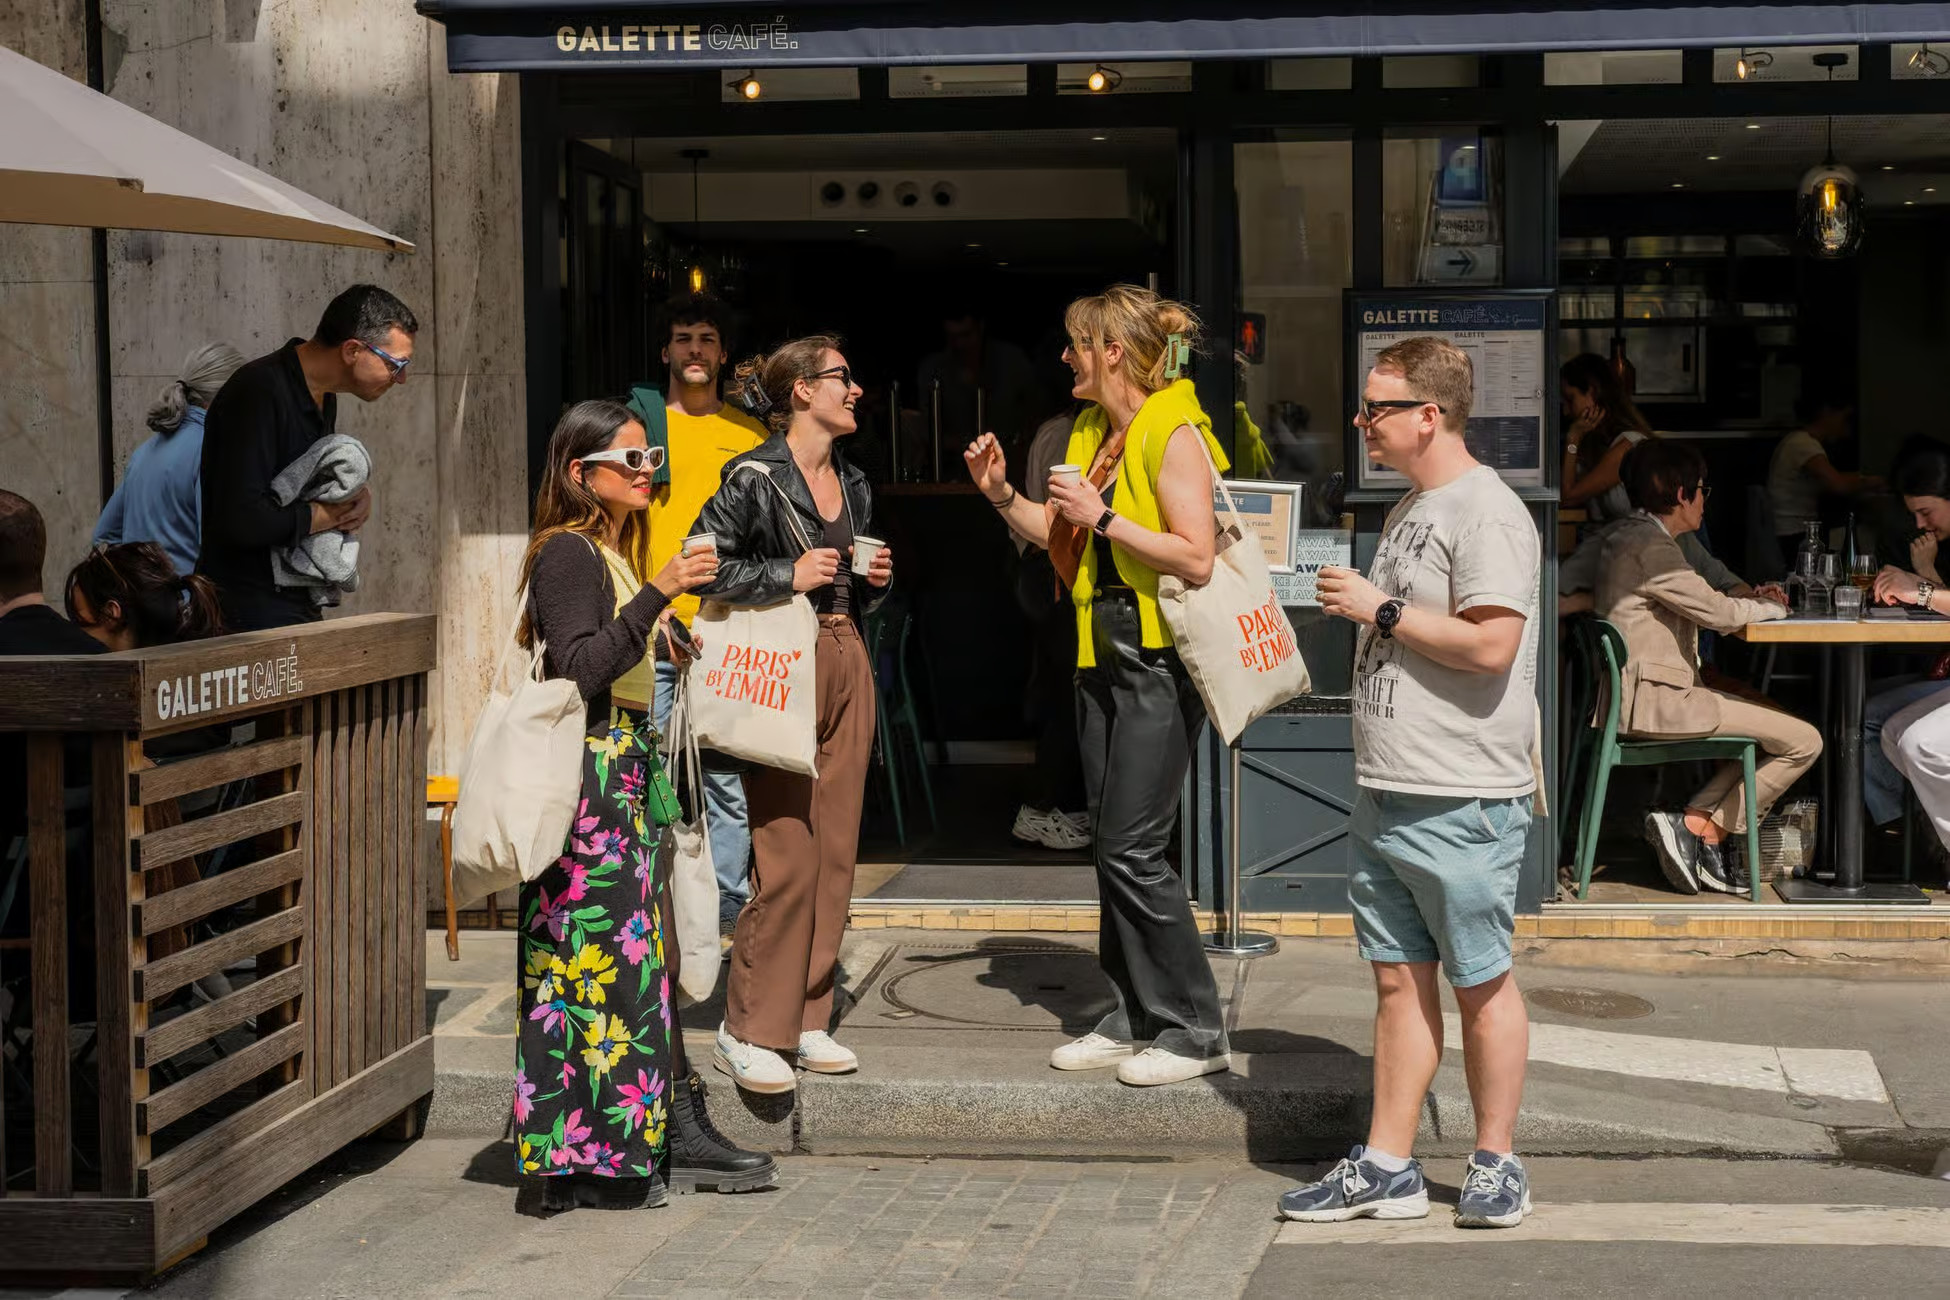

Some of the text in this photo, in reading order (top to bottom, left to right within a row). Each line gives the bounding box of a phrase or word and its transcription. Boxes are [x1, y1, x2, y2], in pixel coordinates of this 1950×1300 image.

[556, 15, 798, 52] GALETTE CAFÉ.
[1363, 309, 1439, 324] GALETTE
[722, 644, 792, 680] PARIS
[1239, 644, 1259, 668] BY
[157, 643, 303, 720] GALETTE CAFÉ.
[705, 669, 792, 712] BY EMILY
